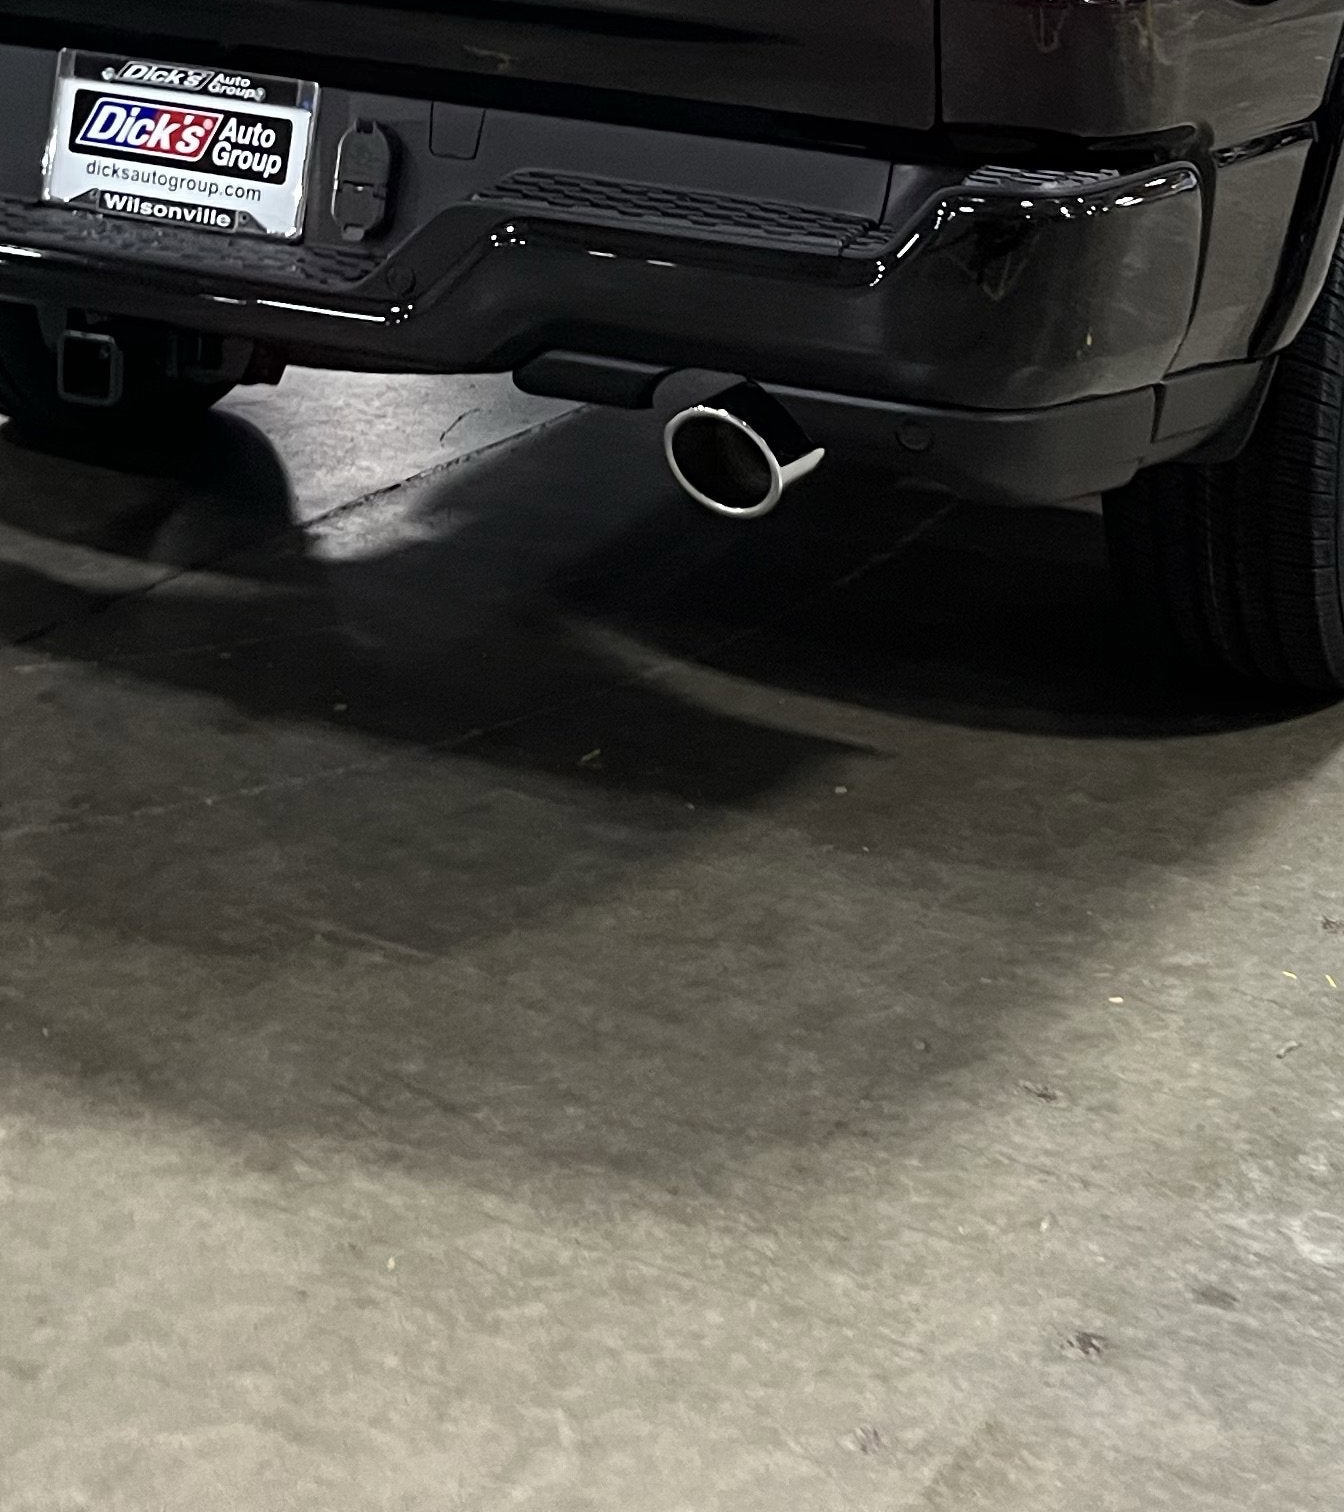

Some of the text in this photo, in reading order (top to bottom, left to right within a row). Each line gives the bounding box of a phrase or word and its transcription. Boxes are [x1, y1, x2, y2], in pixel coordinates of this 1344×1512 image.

[207, 81, 257, 100] Group
[214, 73, 251, 87] Auto
[86, 104, 276, 154] Dick's Auto
[212, 144, 282, 177] Group
[85, 159, 262, 202] dicksautogroup.com
[103, 191, 232, 228] Wilsonville
